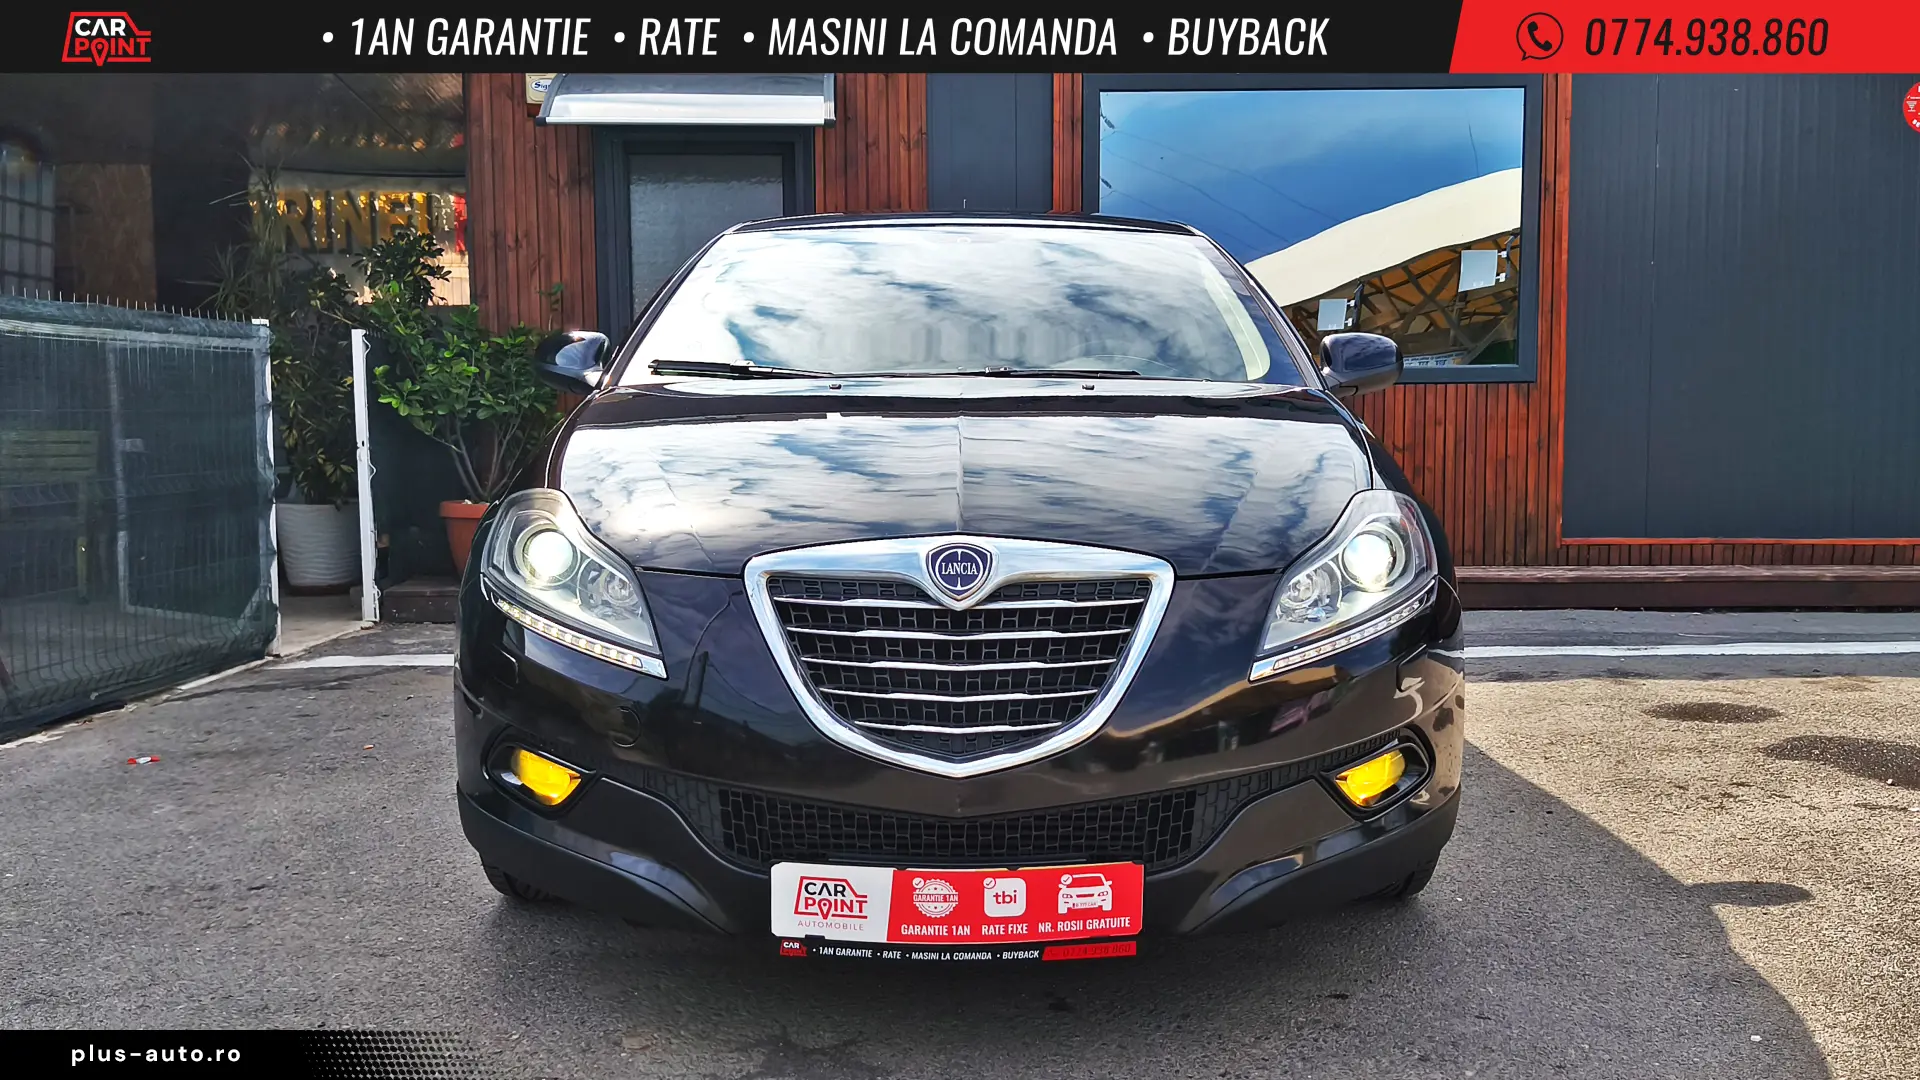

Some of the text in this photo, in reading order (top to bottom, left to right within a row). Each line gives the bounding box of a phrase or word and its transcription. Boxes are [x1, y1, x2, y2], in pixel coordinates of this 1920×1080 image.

[941, 562, 979, 575] LANCIA
[803, 882, 847, 897] CAR
[913, 893, 959, 902] GARANTIE 1AN
[993, 889, 1017, 904] tbi
[804, 897, 868, 920] POINT
[797, 919, 864, 931] AUTOMOBILE
[901, 924, 971, 936] GARANTIE 1AN
[982, 923, 1028, 936] RATE FIXE
[1038, 916, 1131, 933] NR. ROSII GRATUITE
[783, 941, 800, 949] CAR
[819, 946, 1040, 961] 1AN GARANTIE RATE MASINI LA COMANDA BUYBACK
